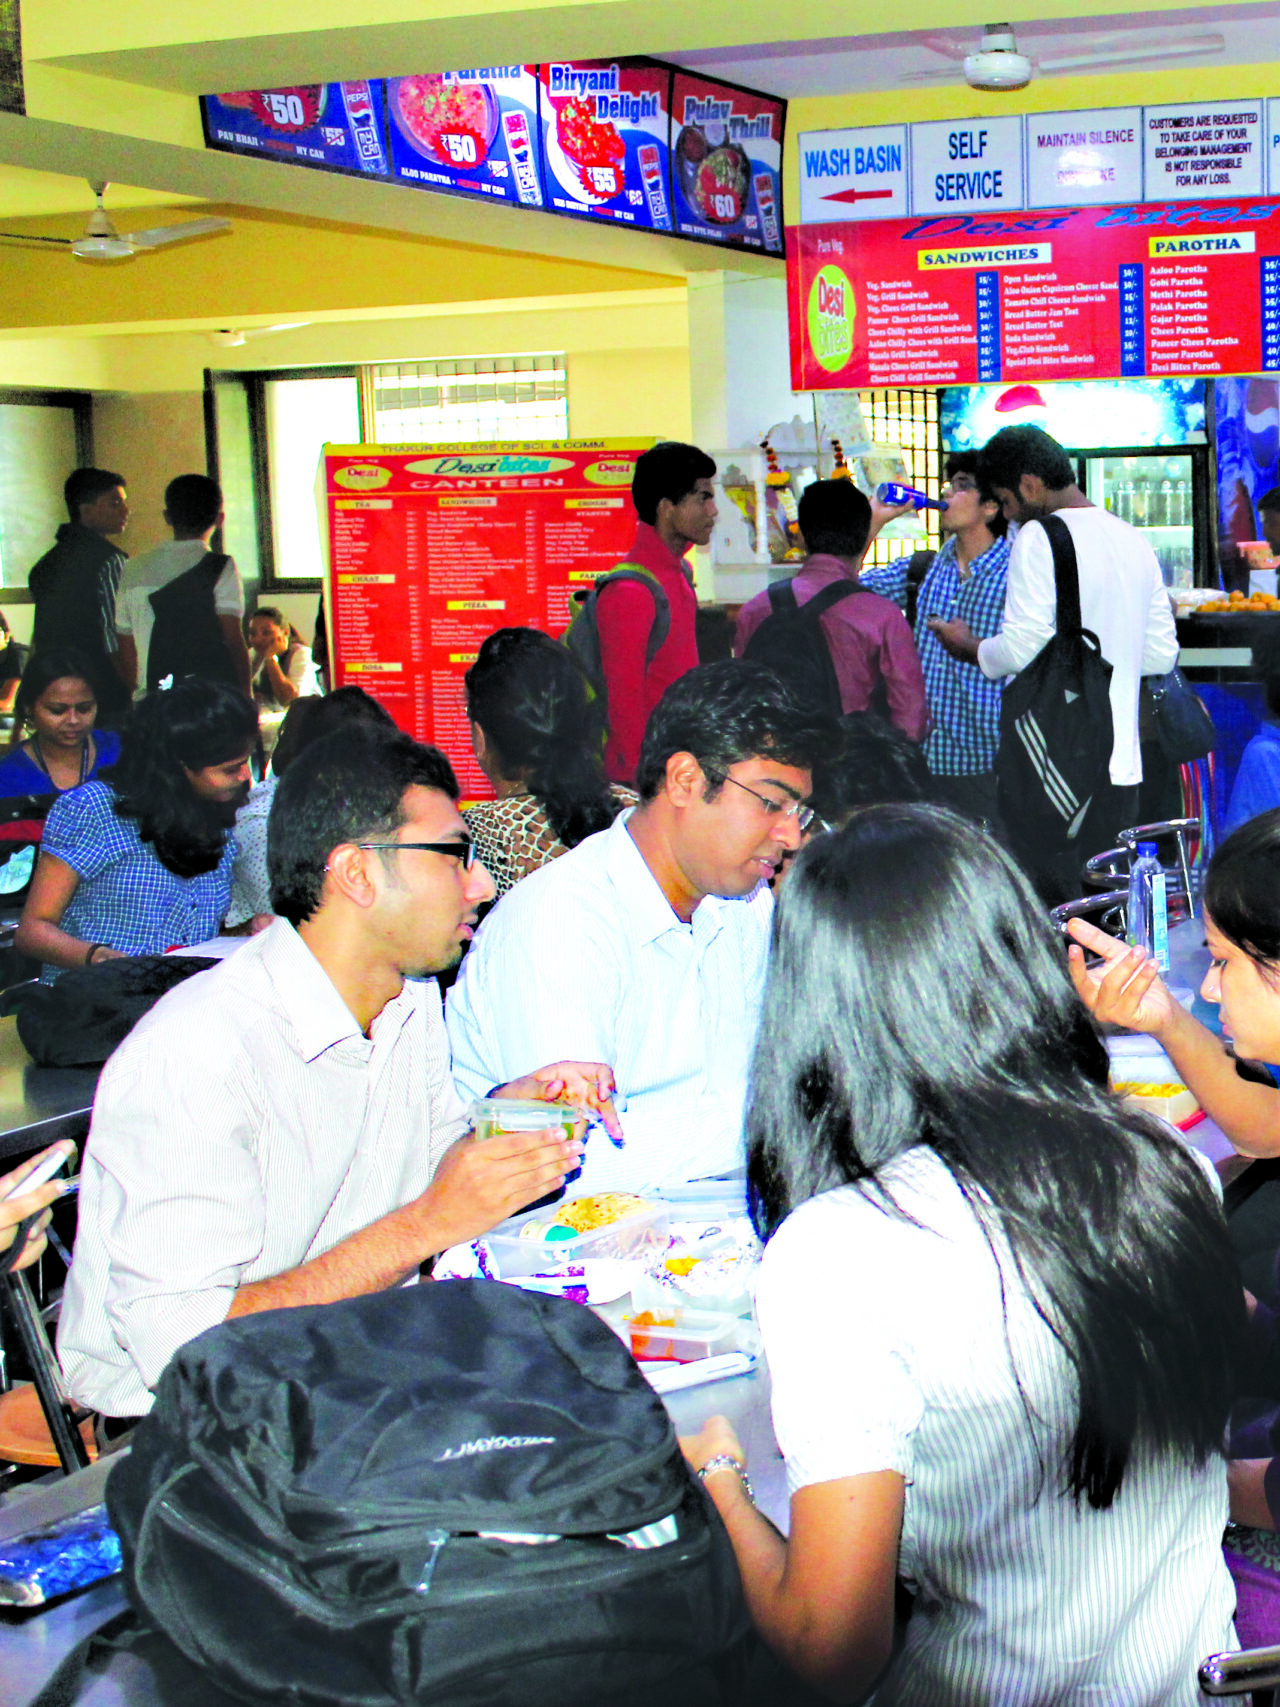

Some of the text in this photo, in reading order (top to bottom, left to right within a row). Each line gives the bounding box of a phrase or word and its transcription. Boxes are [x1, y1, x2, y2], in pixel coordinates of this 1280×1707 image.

[551, 66, 616, 96] Biryani
[598, 94, 657, 123] Delight
[730, 116, 770, 138] Thrill
[1149, 112, 1258, 129] CUSTOMERS ARE REQUESTED
[1037, 129, 1134, 148] MAINTAIN SILENCE
[1160, 128, 1247, 143] TO TAKE CARE OF YOUR
[948, 130, 988, 160] SELF
[1155, 142, 1252, 158] BELONGING MANAGEMENT
[805, 144, 901, 179] WASH BASIN
[1165, 162, 1172, 172] IS
[1174, 161, 1188, 171] NOT
[935, 170, 1002, 202] SERVICE
[1176, 175, 1191, 186] FOR
[1193, 174, 1208, 185] ANY
[1155, 238, 1241, 252] PAROTHA
[924, 248, 1039, 265] SANDWICHES
[409, 478, 563, 489] CANTEEN
